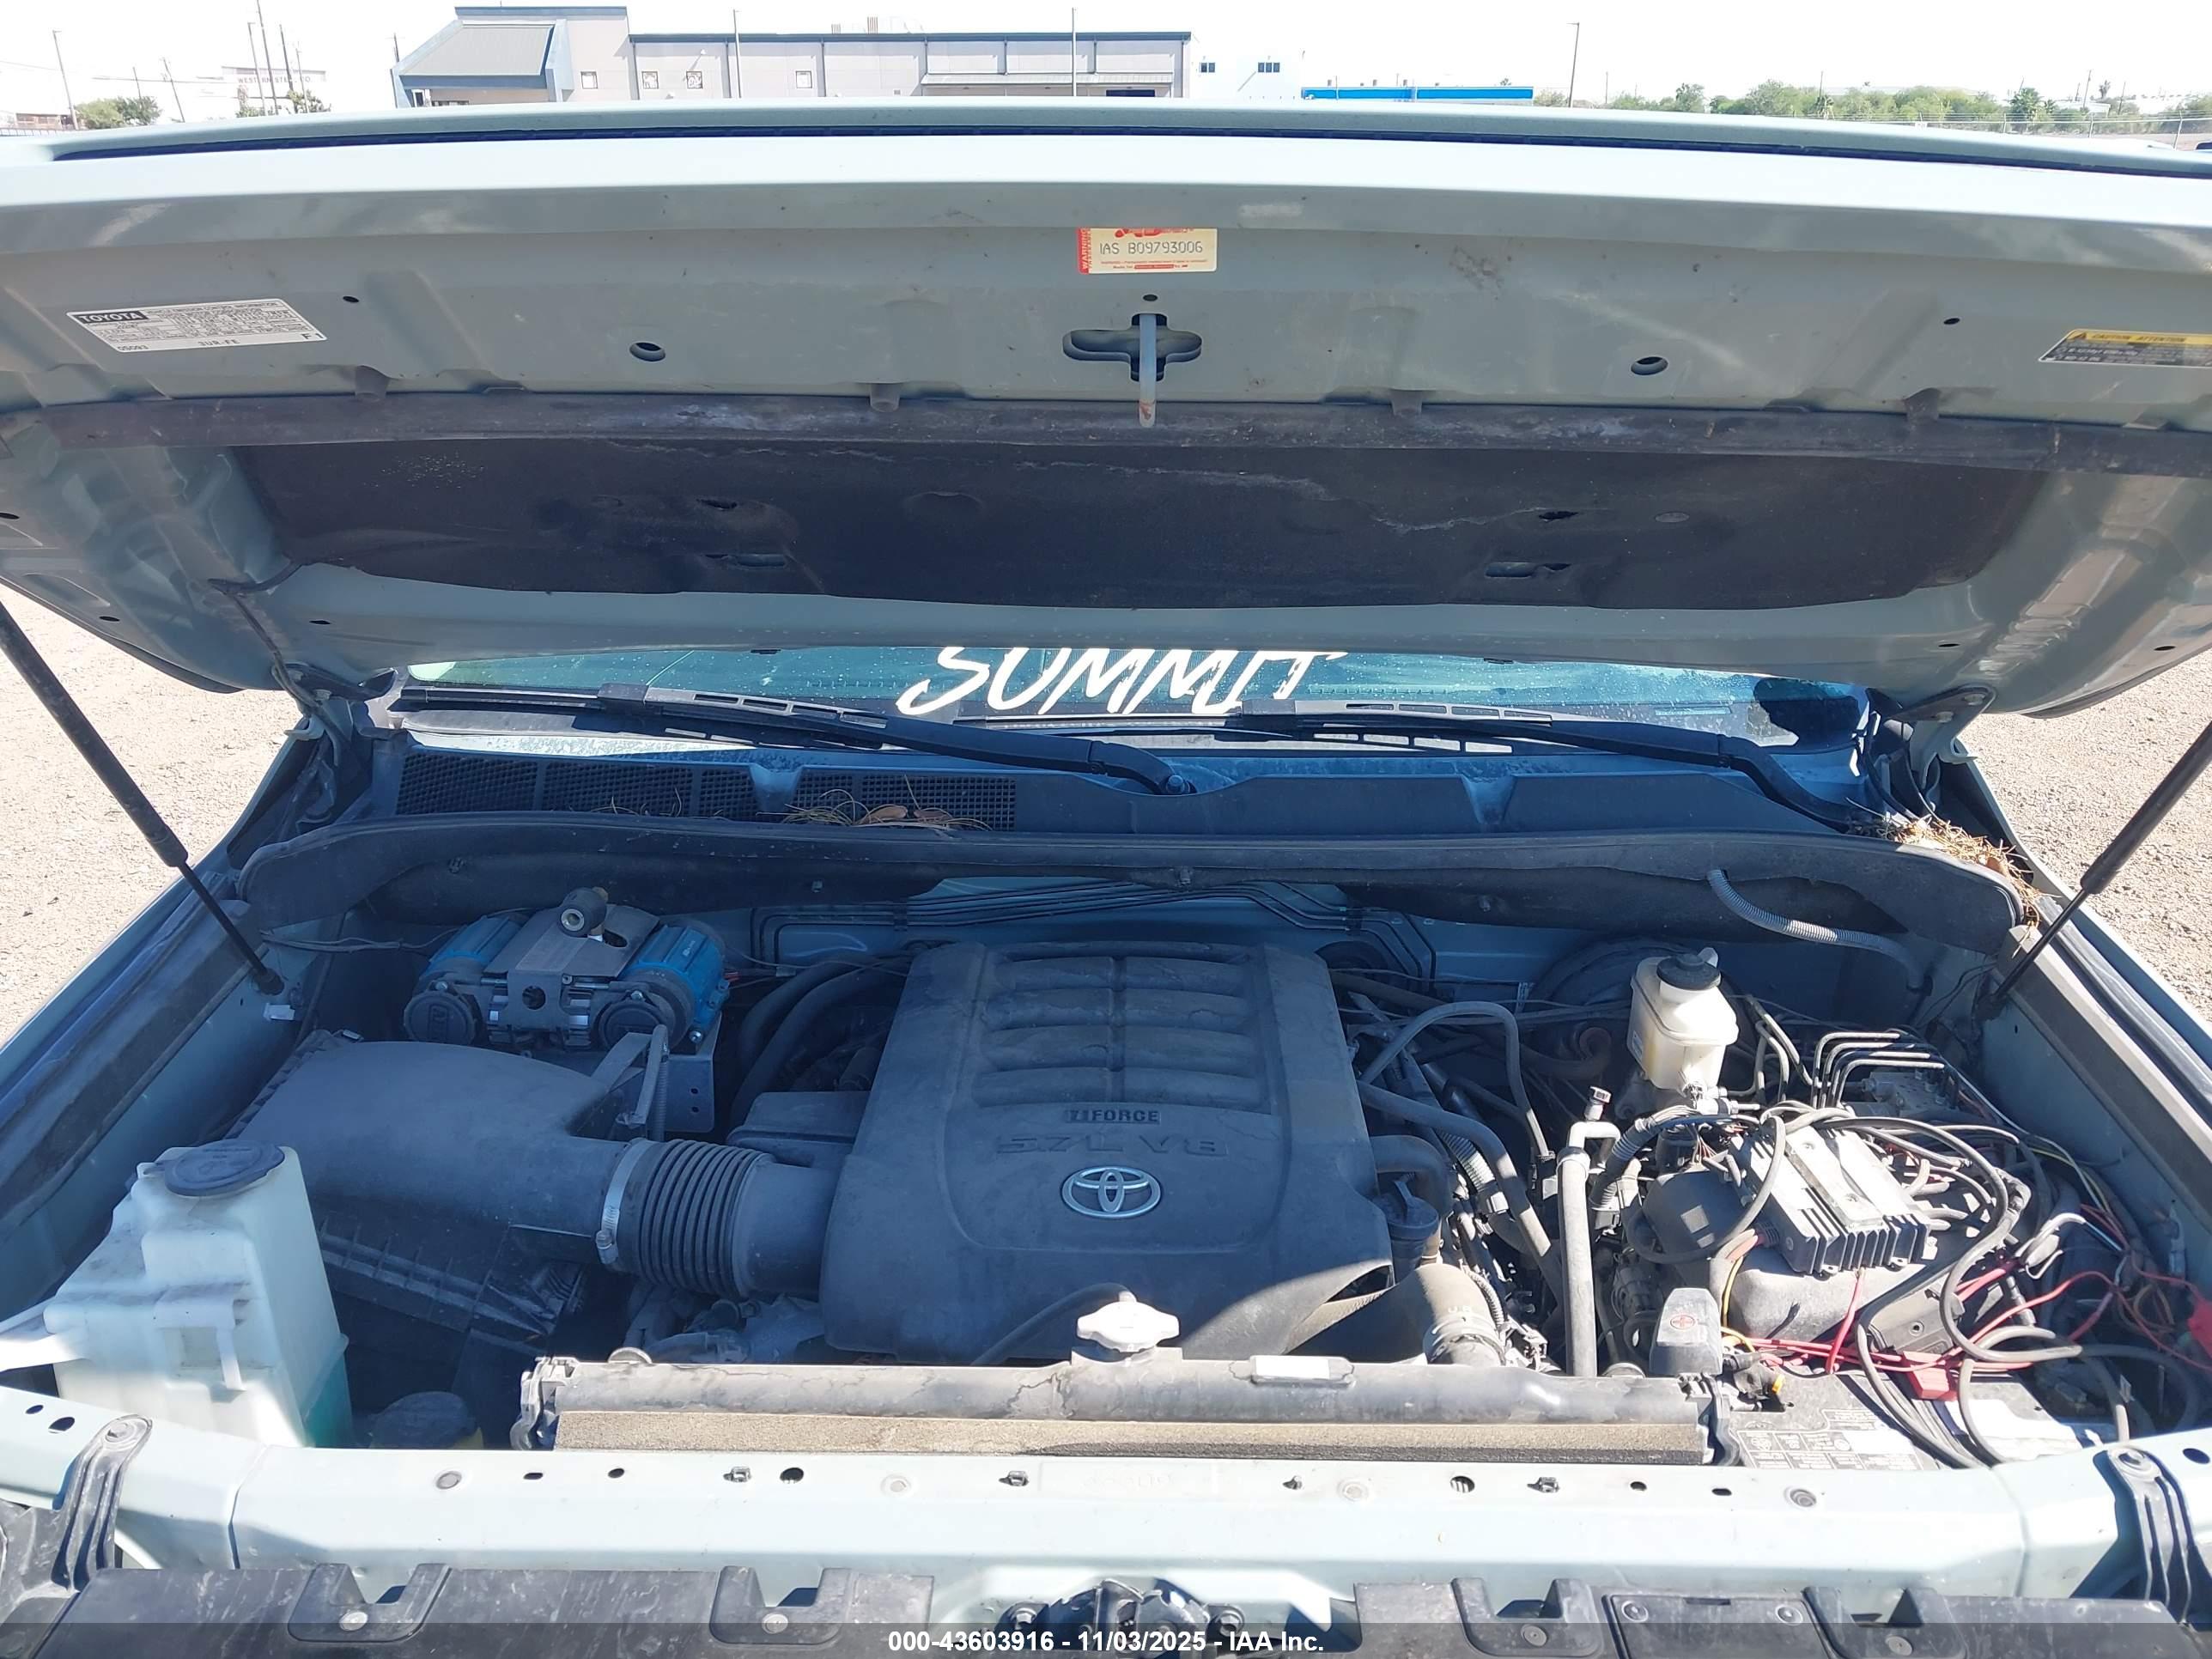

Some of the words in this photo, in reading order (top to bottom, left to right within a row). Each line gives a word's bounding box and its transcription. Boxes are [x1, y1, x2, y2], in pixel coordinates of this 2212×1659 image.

[1100, 242, 1120, 255] IAS
[1127, 240, 1203, 254] B09793006
[78, 311, 143, 323] TOYOTA
[895, 646, 1348, 715] SUMMIT
